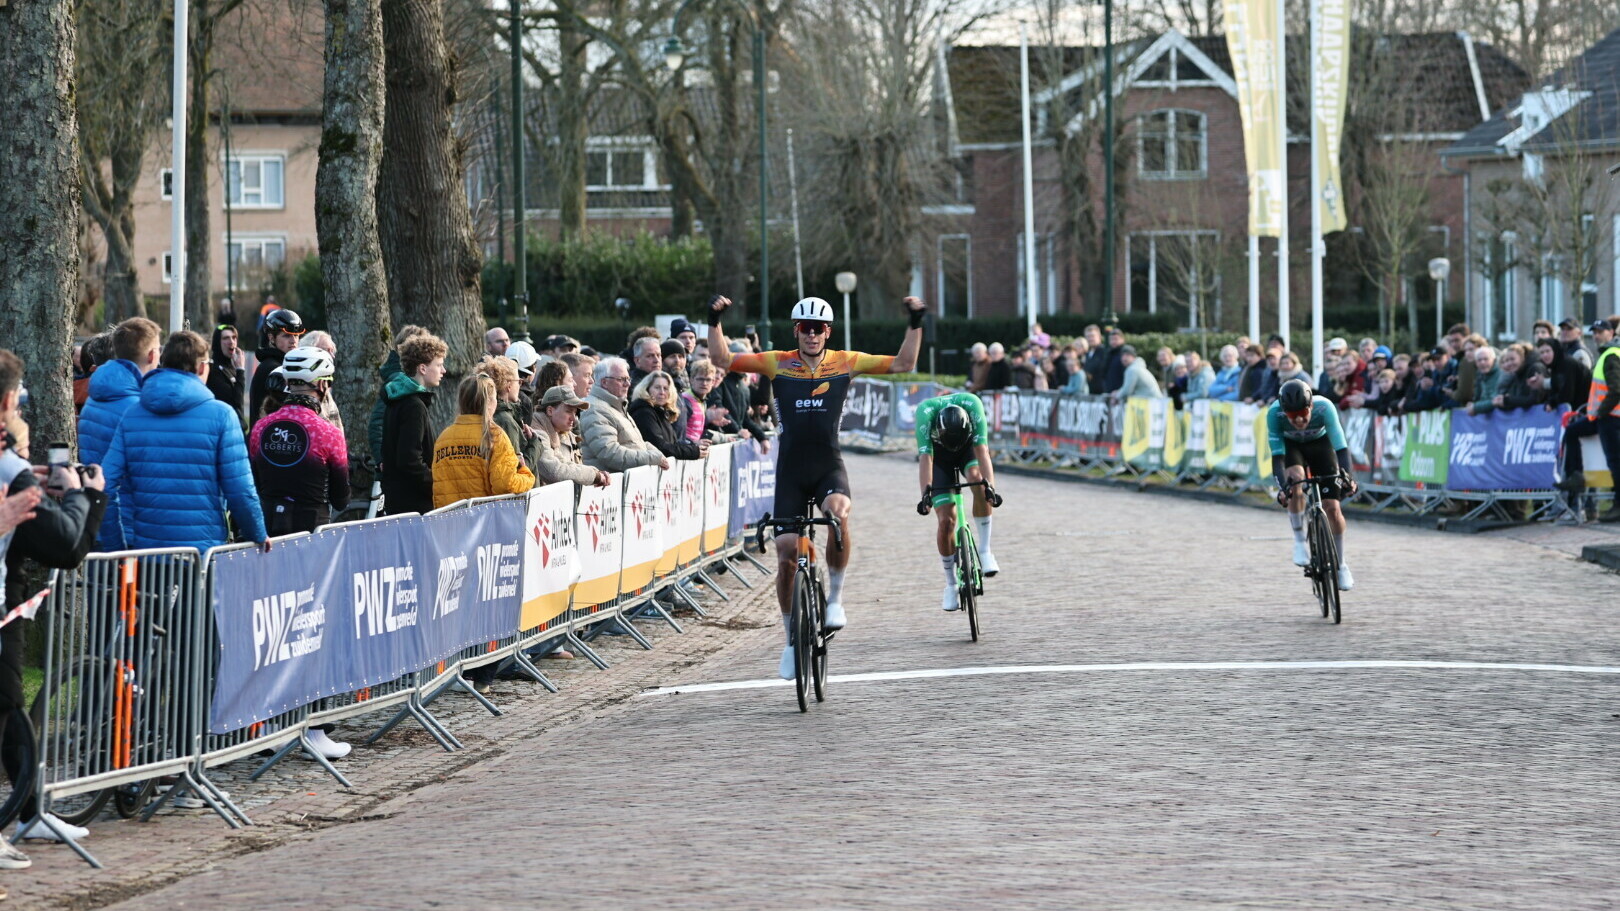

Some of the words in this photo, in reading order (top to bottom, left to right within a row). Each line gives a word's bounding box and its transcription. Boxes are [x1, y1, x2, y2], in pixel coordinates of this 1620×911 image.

[795, 399, 823, 408] eew
[264, 442, 302, 453] EGBERTS
[435, 445, 487, 464] BELLEROS
[1503, 427, 1536, 465] PWZ
[476, 543, 502, 604] PWZ
[353, 566, 396, 640] PWZ
[253, 590, 296, 672] PWZ
